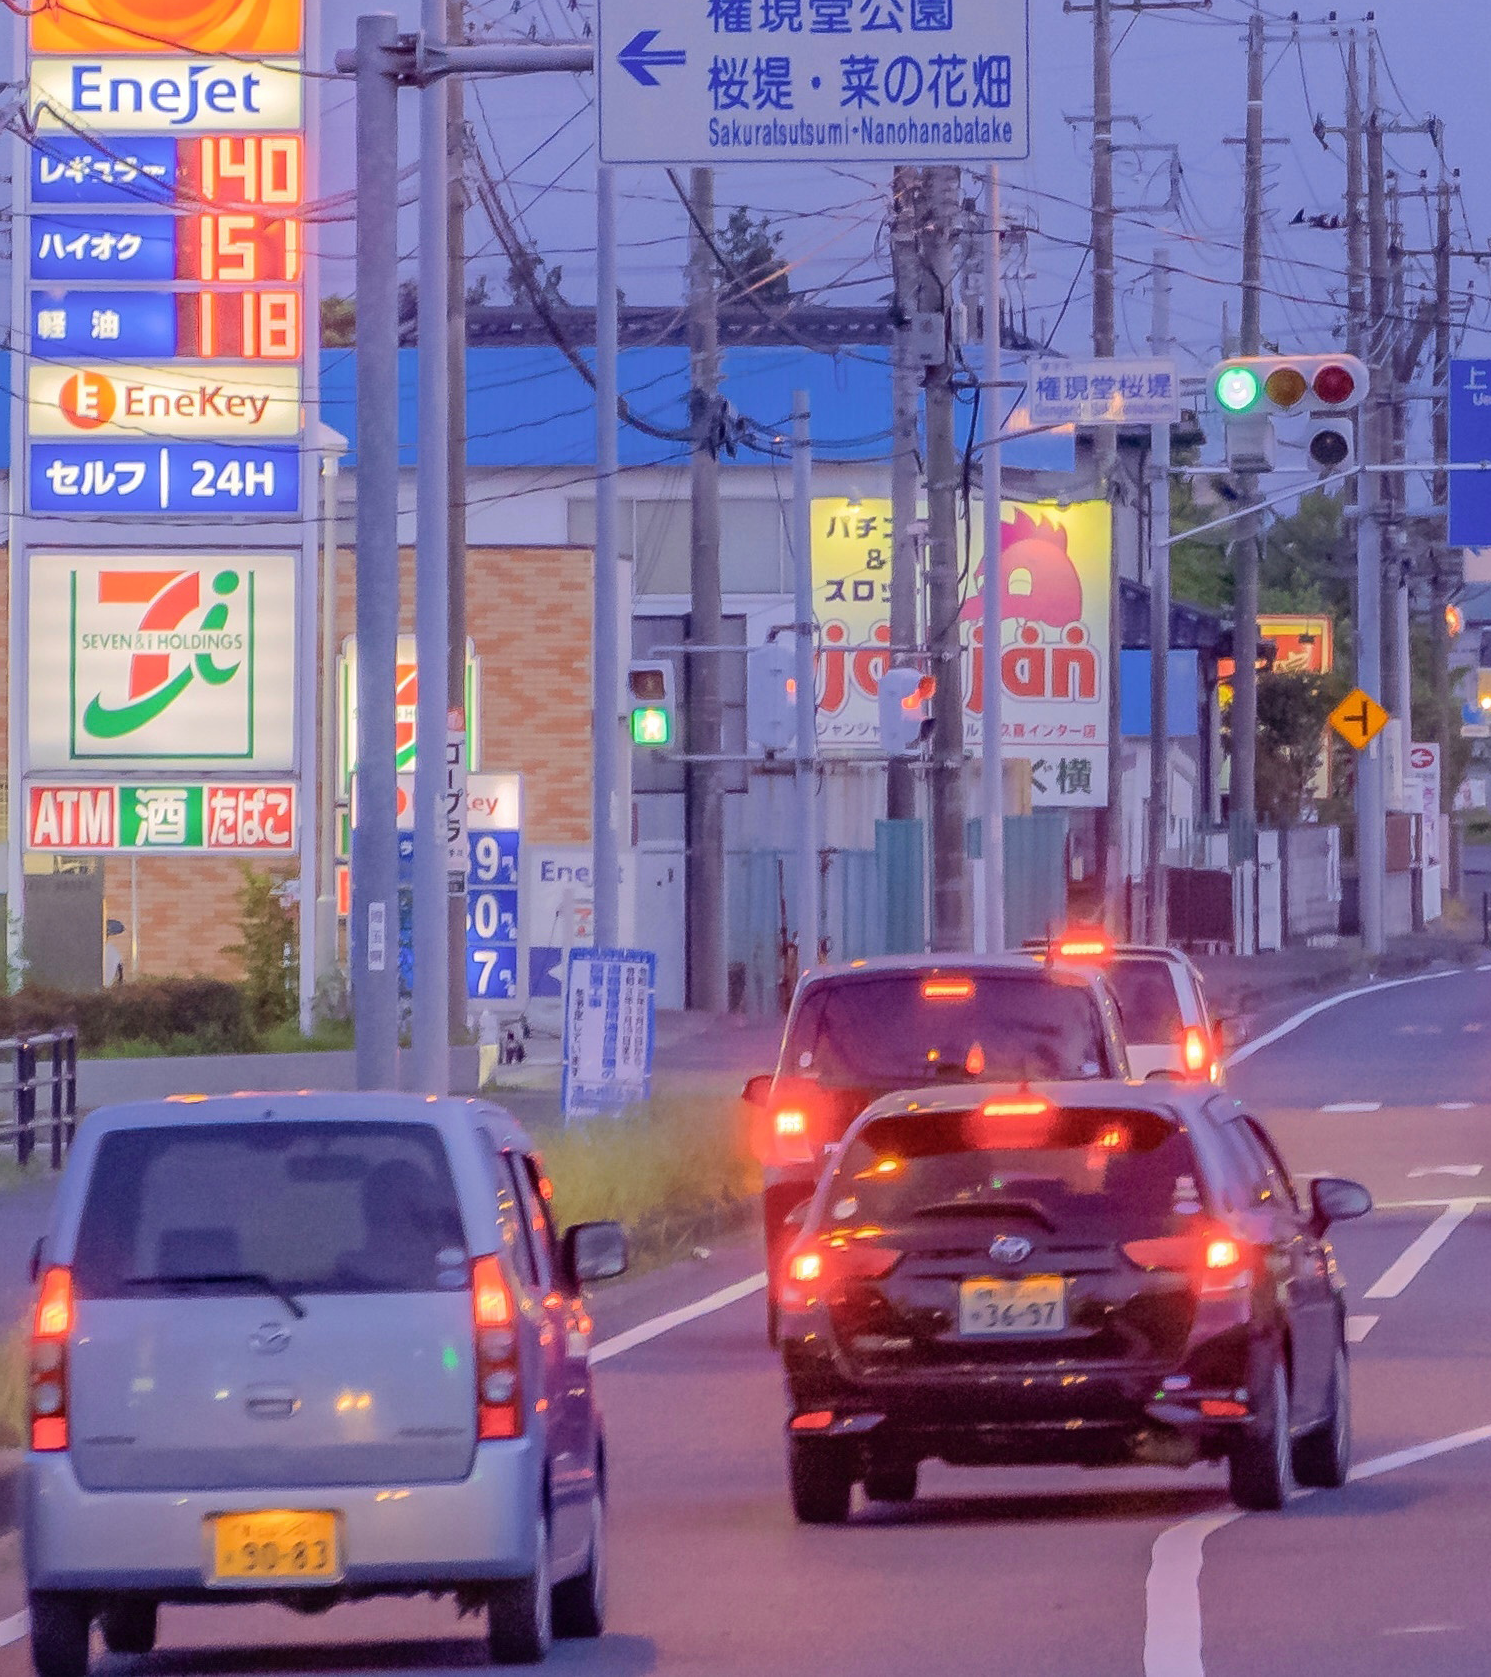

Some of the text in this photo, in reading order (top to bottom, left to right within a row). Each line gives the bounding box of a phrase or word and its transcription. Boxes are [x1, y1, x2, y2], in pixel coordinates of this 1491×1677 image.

[708, 54, 1012, 111] 桜堤・菜の花畑
[39, 138, 299, 203] レギュラー 140
[39, 216, 297, 281] ハイオク 151
[201, 292, 297, 356] 118
[125, 385, 270, 424] EneKey
[46, 459, 276, 497] セルフ 24H
[34, 789, 291, 846] ATM 酒 たばこ
